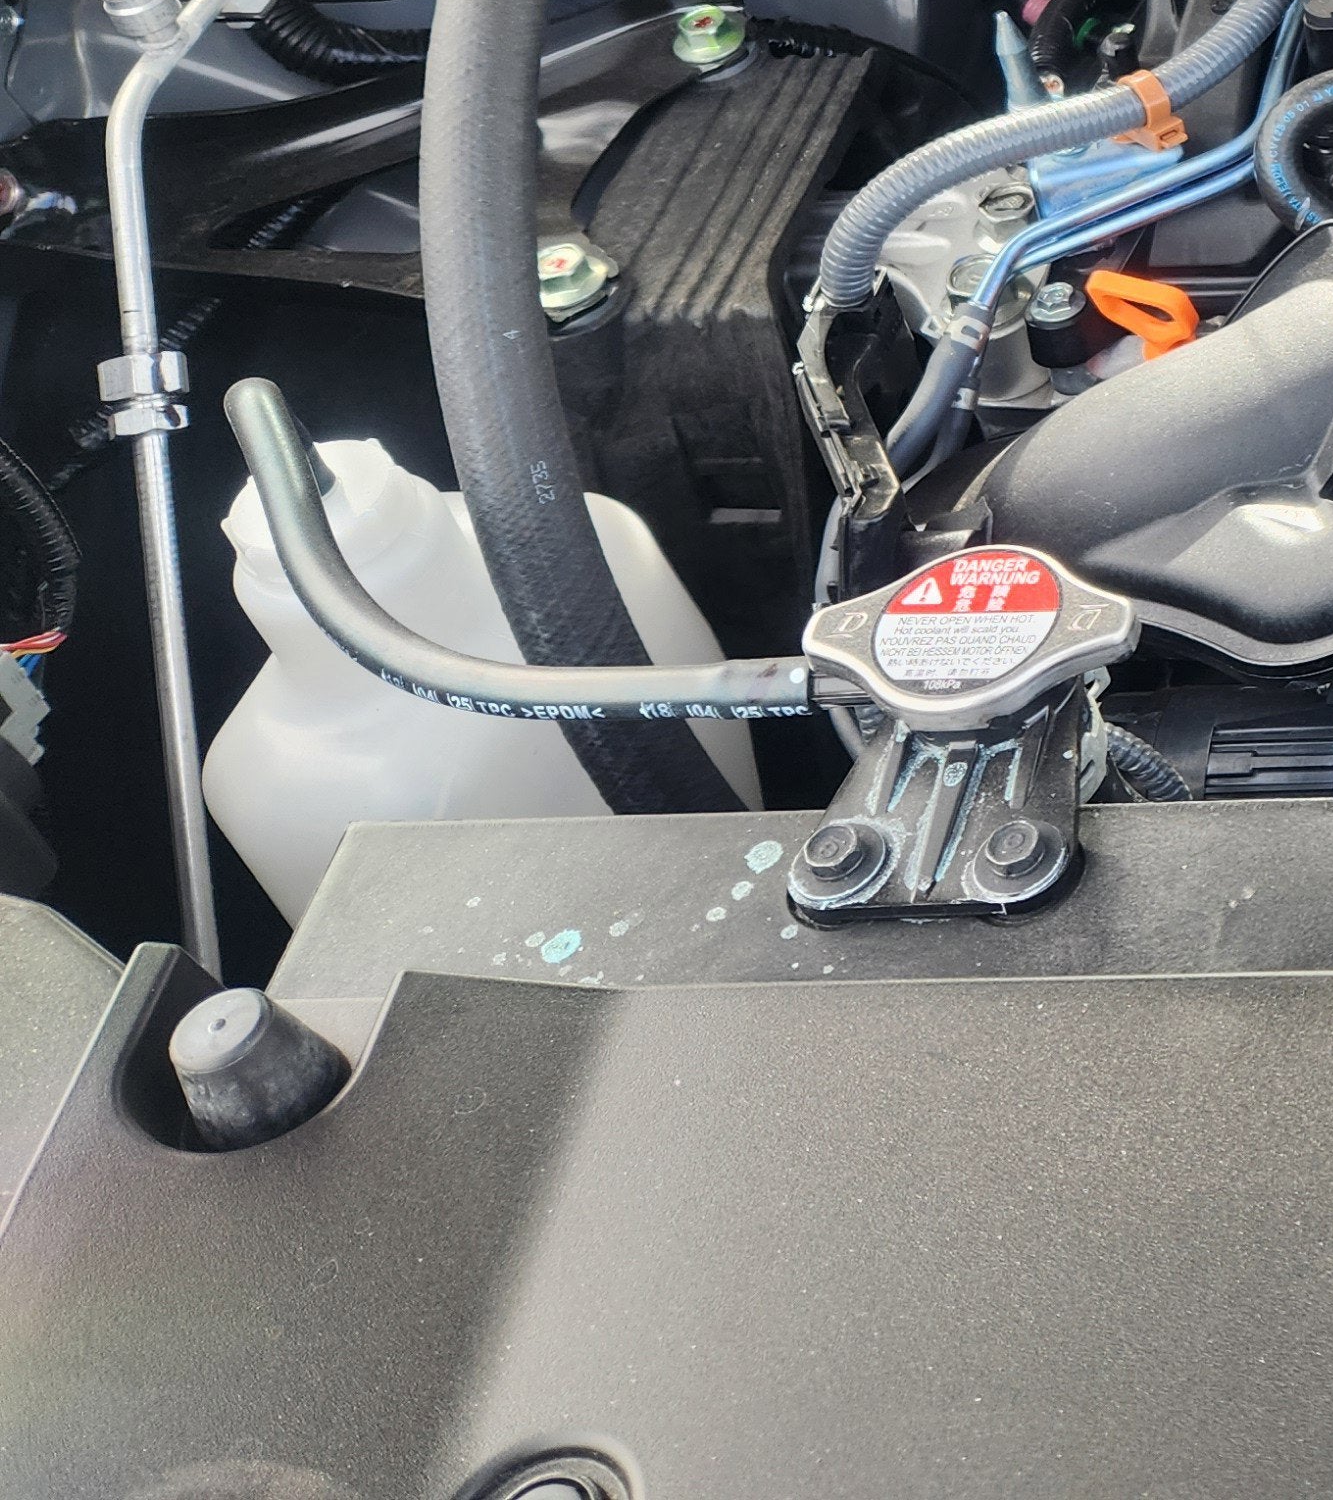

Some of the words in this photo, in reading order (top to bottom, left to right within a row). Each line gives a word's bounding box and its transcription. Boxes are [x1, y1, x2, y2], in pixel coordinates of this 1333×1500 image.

[530, 460, 556, 505] 2735
[953, 559, 1029, 572] DANGER
[950, 572, 1040, 586] WARNUNG
[898, 616, 936, 625] NEVER
[939, 616, 970, 625] OPEN
[974, 615, 1008, 624] WHEN
[915, 626, 951, 634] coolant
[971, 625, 998, 633] scald
[934, 636, 957, 645] PAS
[959, 636, 997, 645] QUAND
[999, 635, 1037, 644] CHAUD
[907, 647, 923, 656] BEI
[961, 646, 994, 655] MOTOR
[477, 701, 516, 718] TPC
[767, 706, 813, 717] TPC
